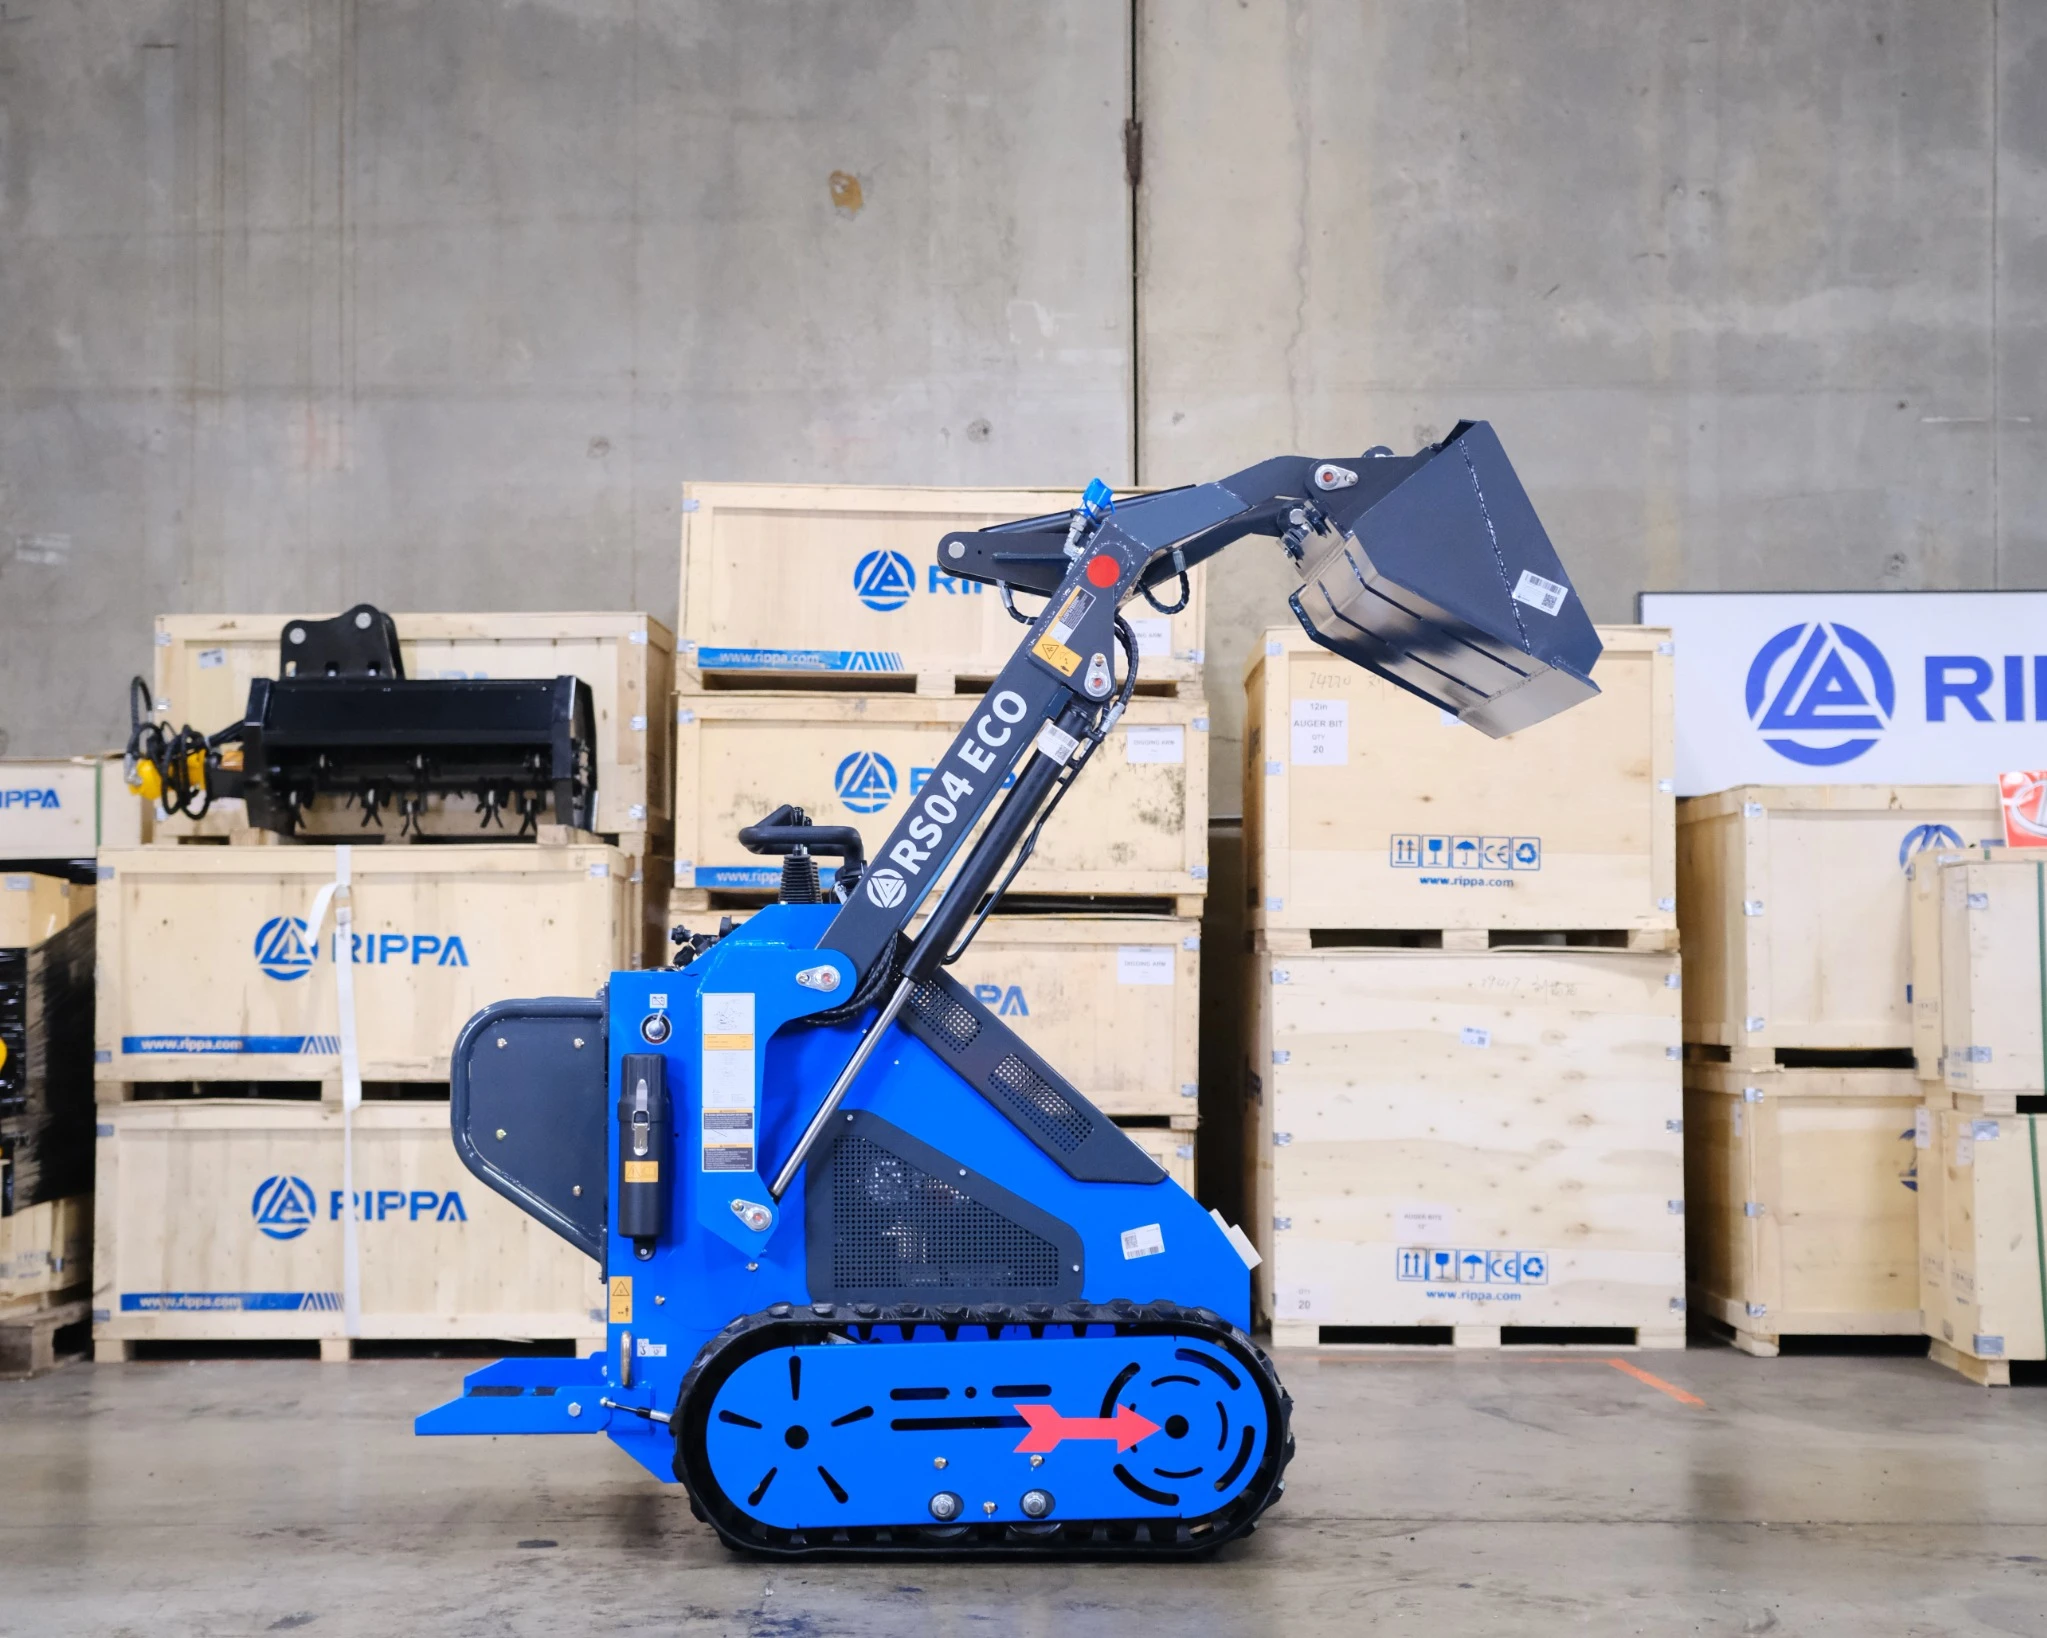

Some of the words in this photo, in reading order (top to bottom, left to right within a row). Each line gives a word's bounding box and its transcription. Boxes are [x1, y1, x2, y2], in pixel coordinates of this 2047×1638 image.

[719, 651, 819, 665] www.rippa.com
[1925, 655, 2047, 722] RI
[1310, 703, 1328, 711] 12in
[1293, 720, 1326, 728] AUGER
[1328, 720, 1343, 728] BIT
[1313, 745, 1324, 754] 20
[888, 770, 974, 876] RS04
[957, 690, 1027, 774] ECO
[1420, 876, 1514, 888] www.rippa.com
[140, 1037, 243, 1052] www.rippa.com
[1426, 1289, 1521, 1301] www.rippa.com
[139, 1294, 241, 1309] www.rippa.com
[1298, 1300, 1311, 1310] 20
